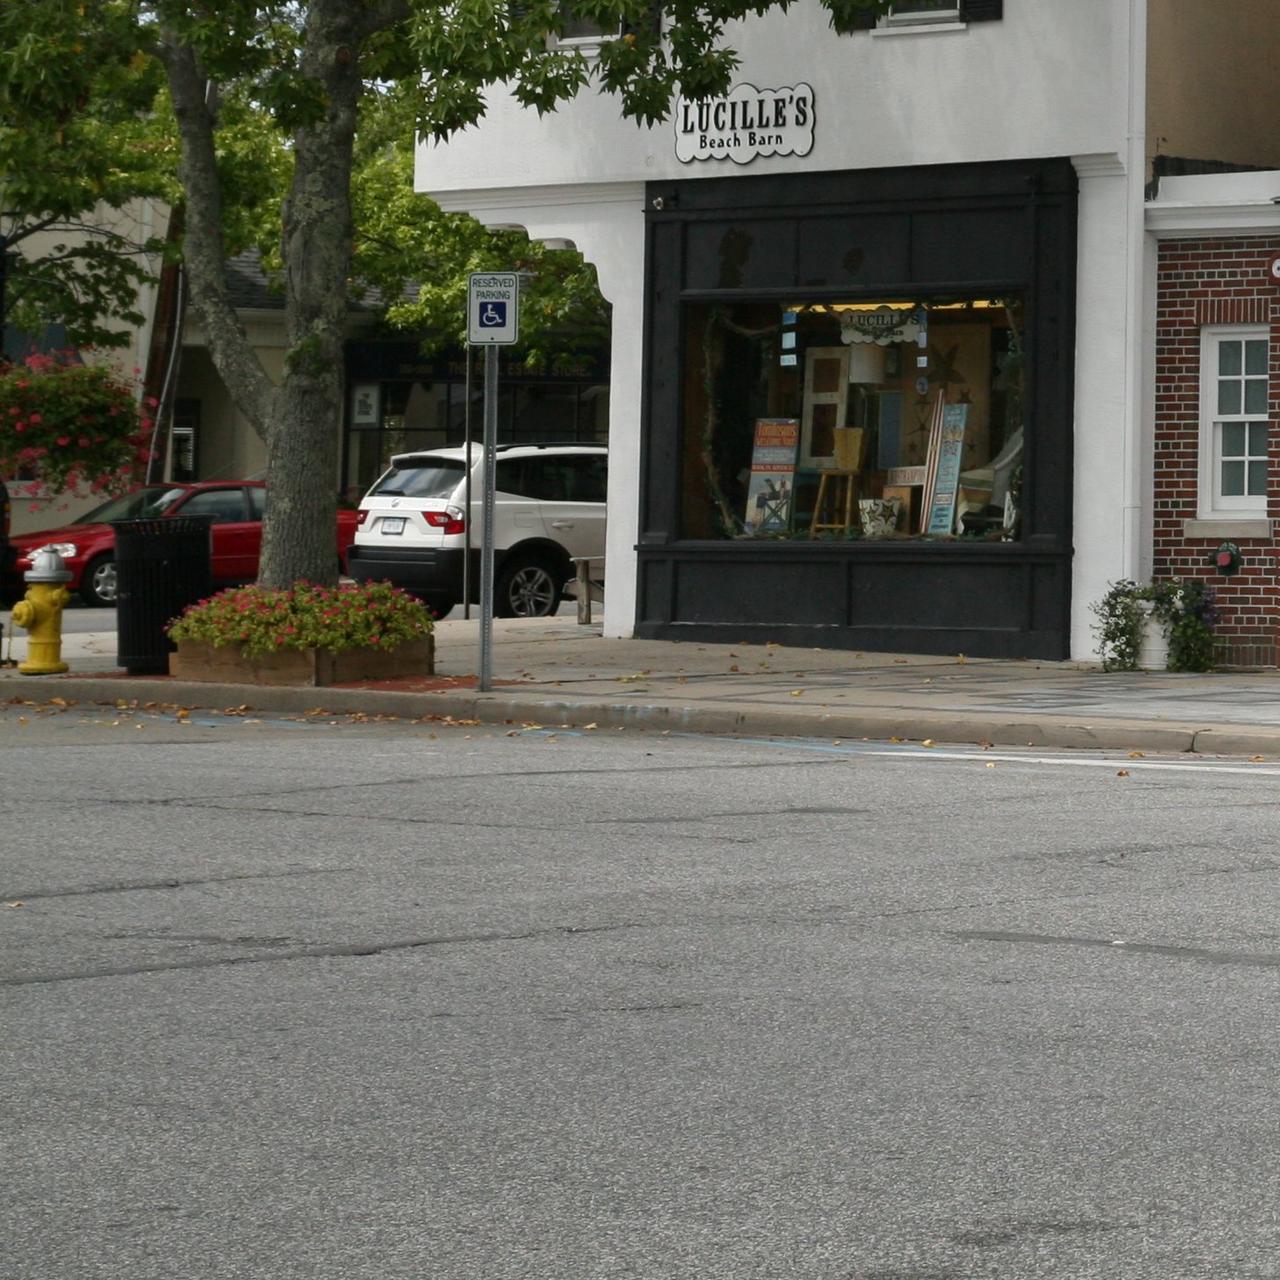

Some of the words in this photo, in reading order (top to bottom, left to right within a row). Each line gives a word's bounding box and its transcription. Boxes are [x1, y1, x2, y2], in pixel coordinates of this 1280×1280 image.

[682, 94, 808, 133] LUCILLE'S
[700, 132, 741, 149] Beach
[749, 131, 783, 146] Barn
[472, 278, 515, 288] RESERVED
[476, 290, 511, 300] PARKING
